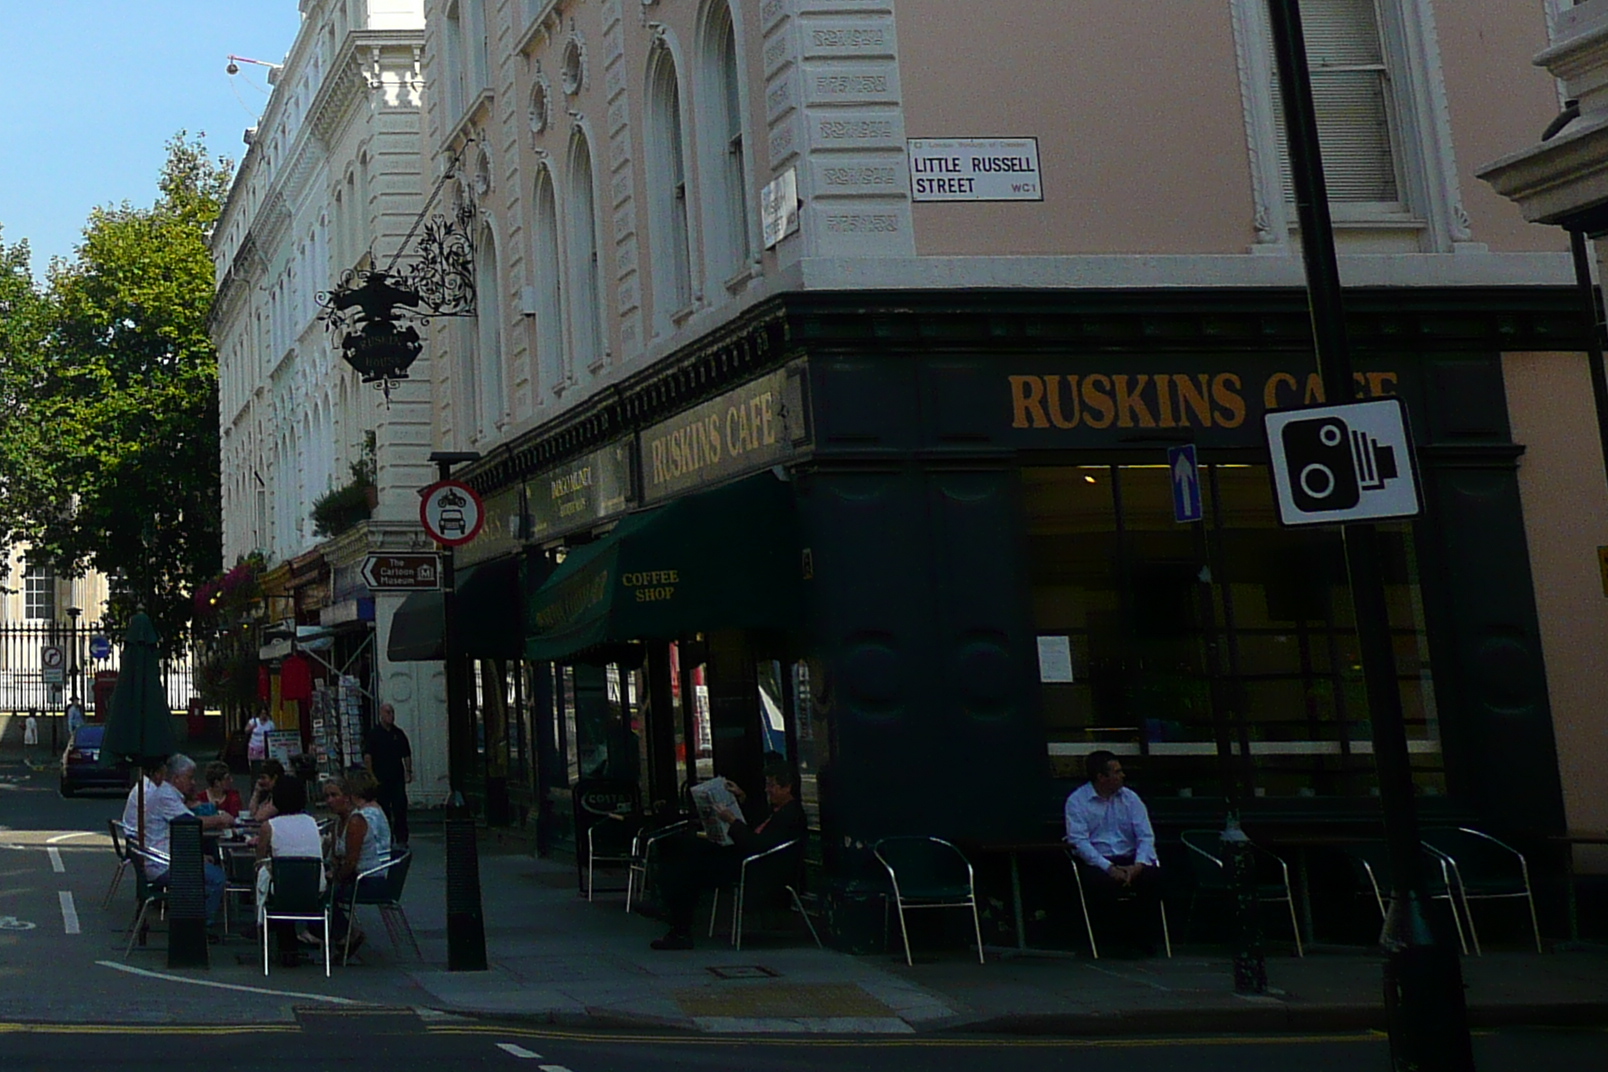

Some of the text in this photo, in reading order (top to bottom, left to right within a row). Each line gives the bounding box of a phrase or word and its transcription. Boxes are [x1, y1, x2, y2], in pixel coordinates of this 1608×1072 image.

[914, 156, 1035, 173] LITTLE RUSSELL
[916, 178, 1036, 194] STREET WC1
[1007, 371, 1398, 430] RUSKINS CE
[650, 413, 722, 484] RUSKINS
[725, 391, 776, 457] CAFE
[389, 558, 405, 567] The
[380, 567, 415, 576] Cartoon
[622, 569, 680, 587] COFFEE
[380, 576, 415, 585] Museum
[635, 585, 675, 603] SHOP
